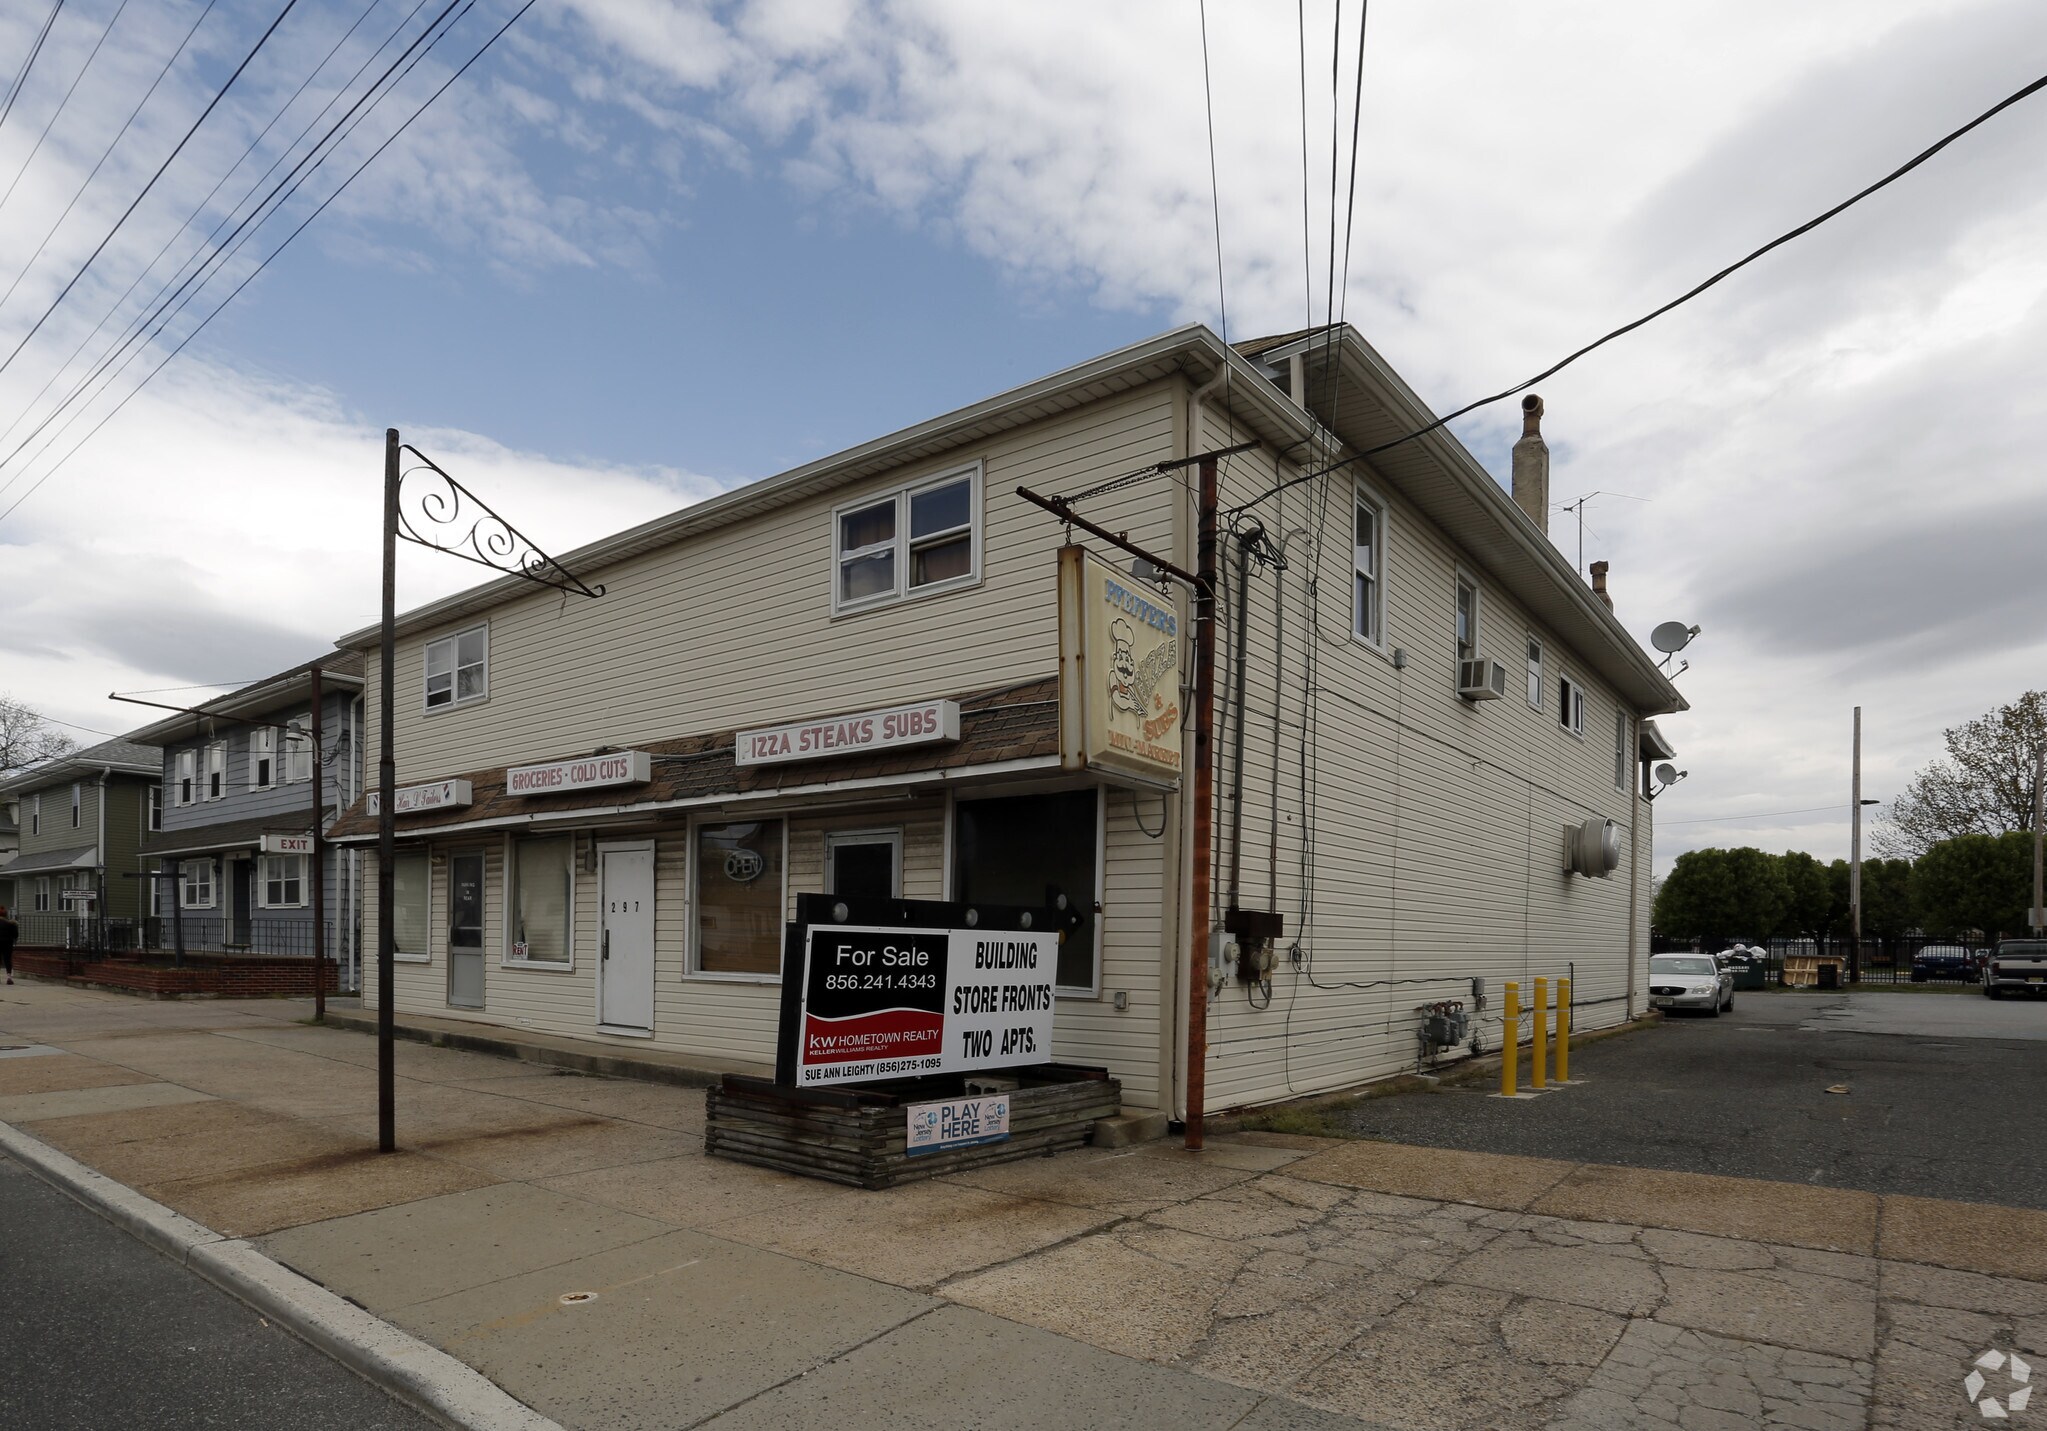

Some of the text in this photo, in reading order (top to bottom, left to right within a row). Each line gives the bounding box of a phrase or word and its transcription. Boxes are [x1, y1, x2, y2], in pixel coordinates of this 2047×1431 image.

[1105, 579, 1176, 636] PFEFFER'S
[1135, 640, 1176, 707] PIZZA
[1155, 693, 1163, 710] &
[799, 719, 873, 751] STEAKS
[883, 709, 937, 739] SUBS
[1143, 703, 1178, 741] SUBS
[512, 767, 563, 790] GROCERIES
[571, 763, 596, 783] COLD
[600, 758, 627, 779] CUTS
[281, 839, 307, 850] EXIT
[726, 856, 758, 875] OPEN
[836, 945, 929, 966] For Sale
[975, 941, 1038, 969] BUILDING
[826, 974, 936, 989] 856.241.4343
[953, 984, 1051, 1014] STORE FRONTS
[839, 1032, 901, 1046] HOMETOWN
[903, 1029, 939, 1042] REALTY
[963, 1026, 1036, 1058] TWO APTS.
[805, 1069, 821, 1080] SUE
[824, 1069, 840, 1079] ANN
[843, 1064, 875, 1077] LEIGHTY
[941, 1102, 981, 1122] PLAY
[916, 1128, 932, 1136] Jersey
[941, 1119, 980, 1139] HERE
